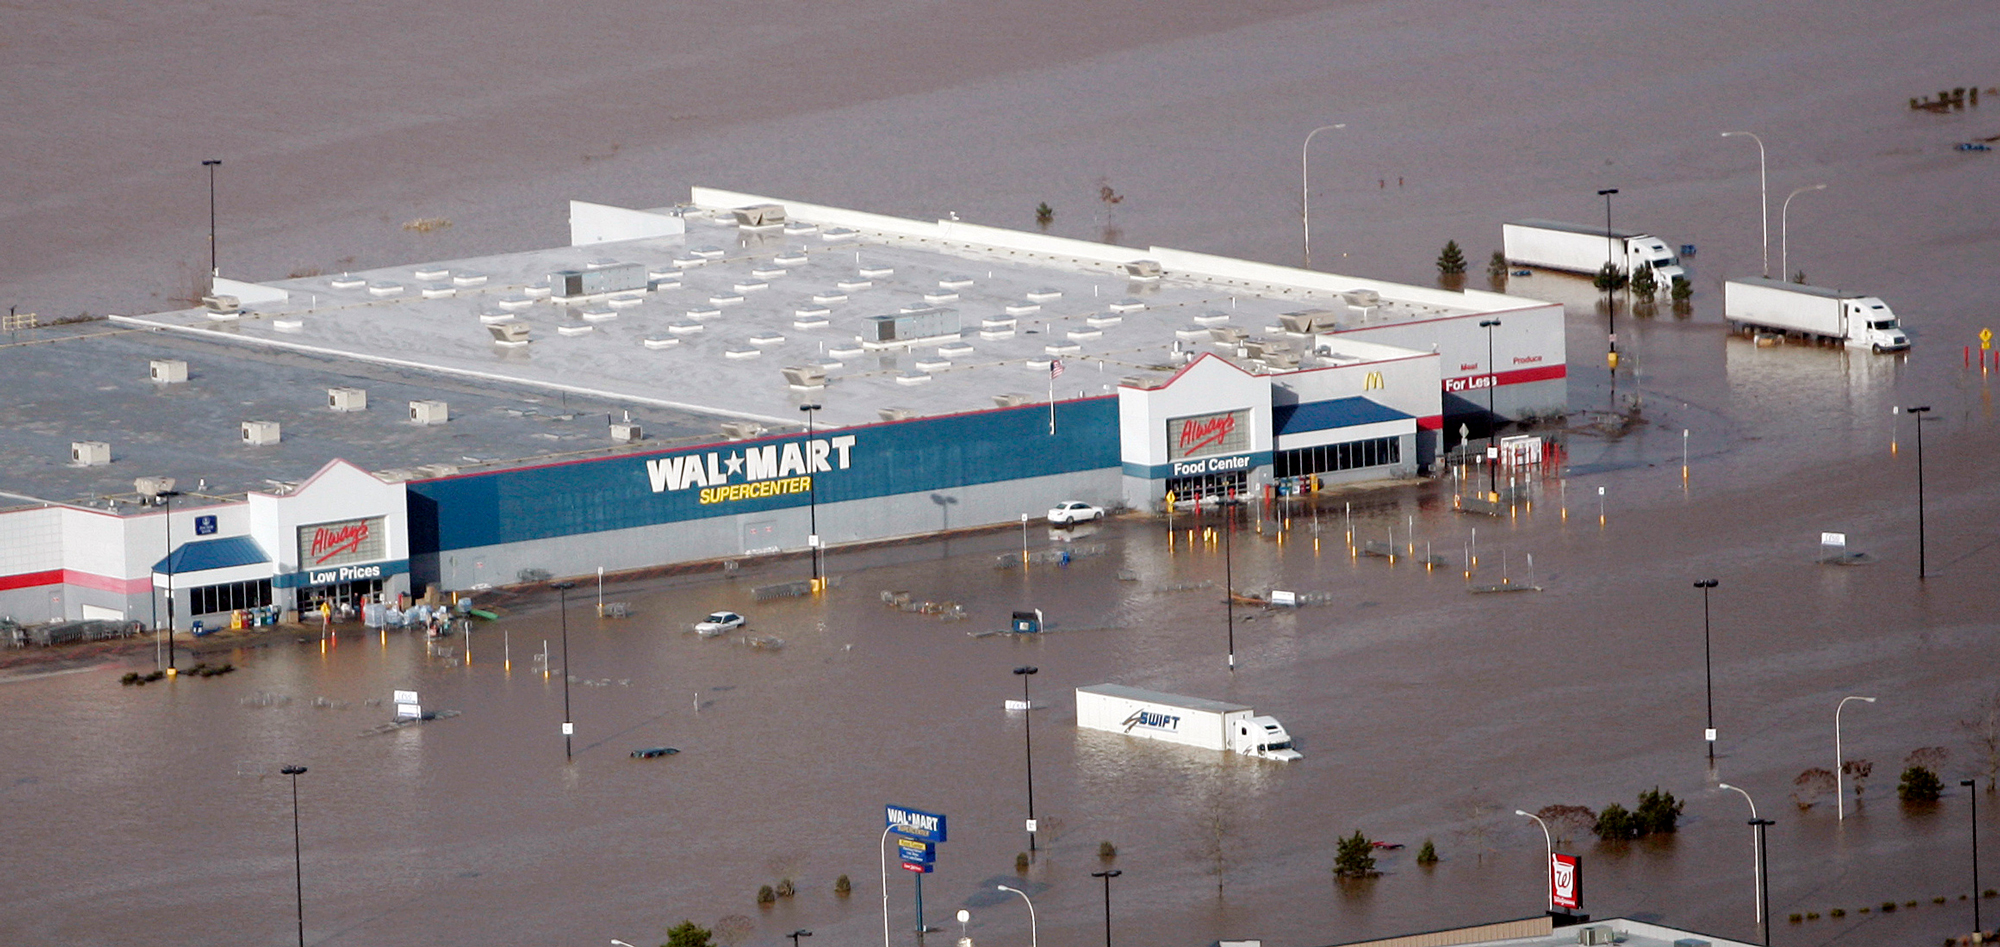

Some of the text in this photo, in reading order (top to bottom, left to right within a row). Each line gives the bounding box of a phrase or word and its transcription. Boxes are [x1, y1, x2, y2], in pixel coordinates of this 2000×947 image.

[1513, 356, 1543, 365] Produce
[1446, 376, 1498, 392] For Less
[1180, 412, 1235, 449] Always
[1174, 456, 1250, 476] Food Center
[700, 476, 812, 505] SUPERCENTER
[311, 519, 369, 556] Always
[309, 565, 381, 585] Low Prices
[1139, 711, 1181, 730] SWIFT
